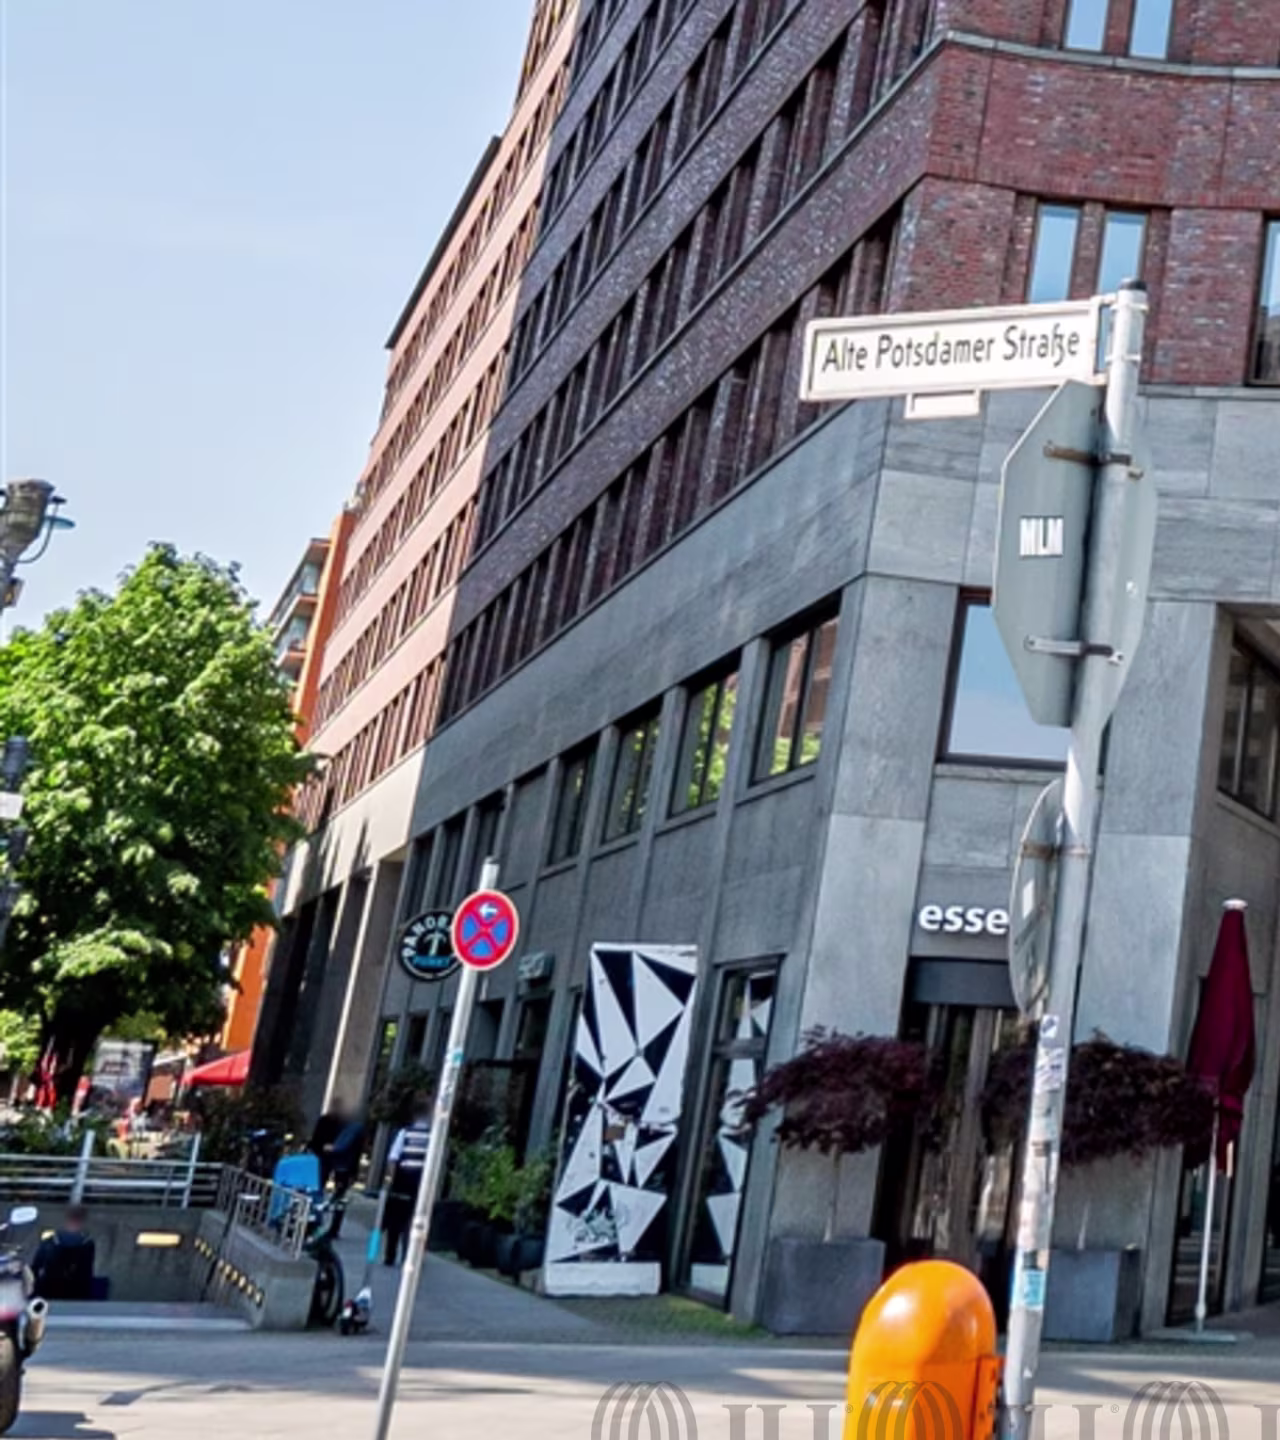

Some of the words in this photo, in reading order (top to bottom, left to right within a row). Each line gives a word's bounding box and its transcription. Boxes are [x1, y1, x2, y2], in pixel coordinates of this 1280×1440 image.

[821, 337, 868, 373] Alte
[876, 331, 996, 369] Potsdamer
[1003, 322, 1081, 368] Straße
